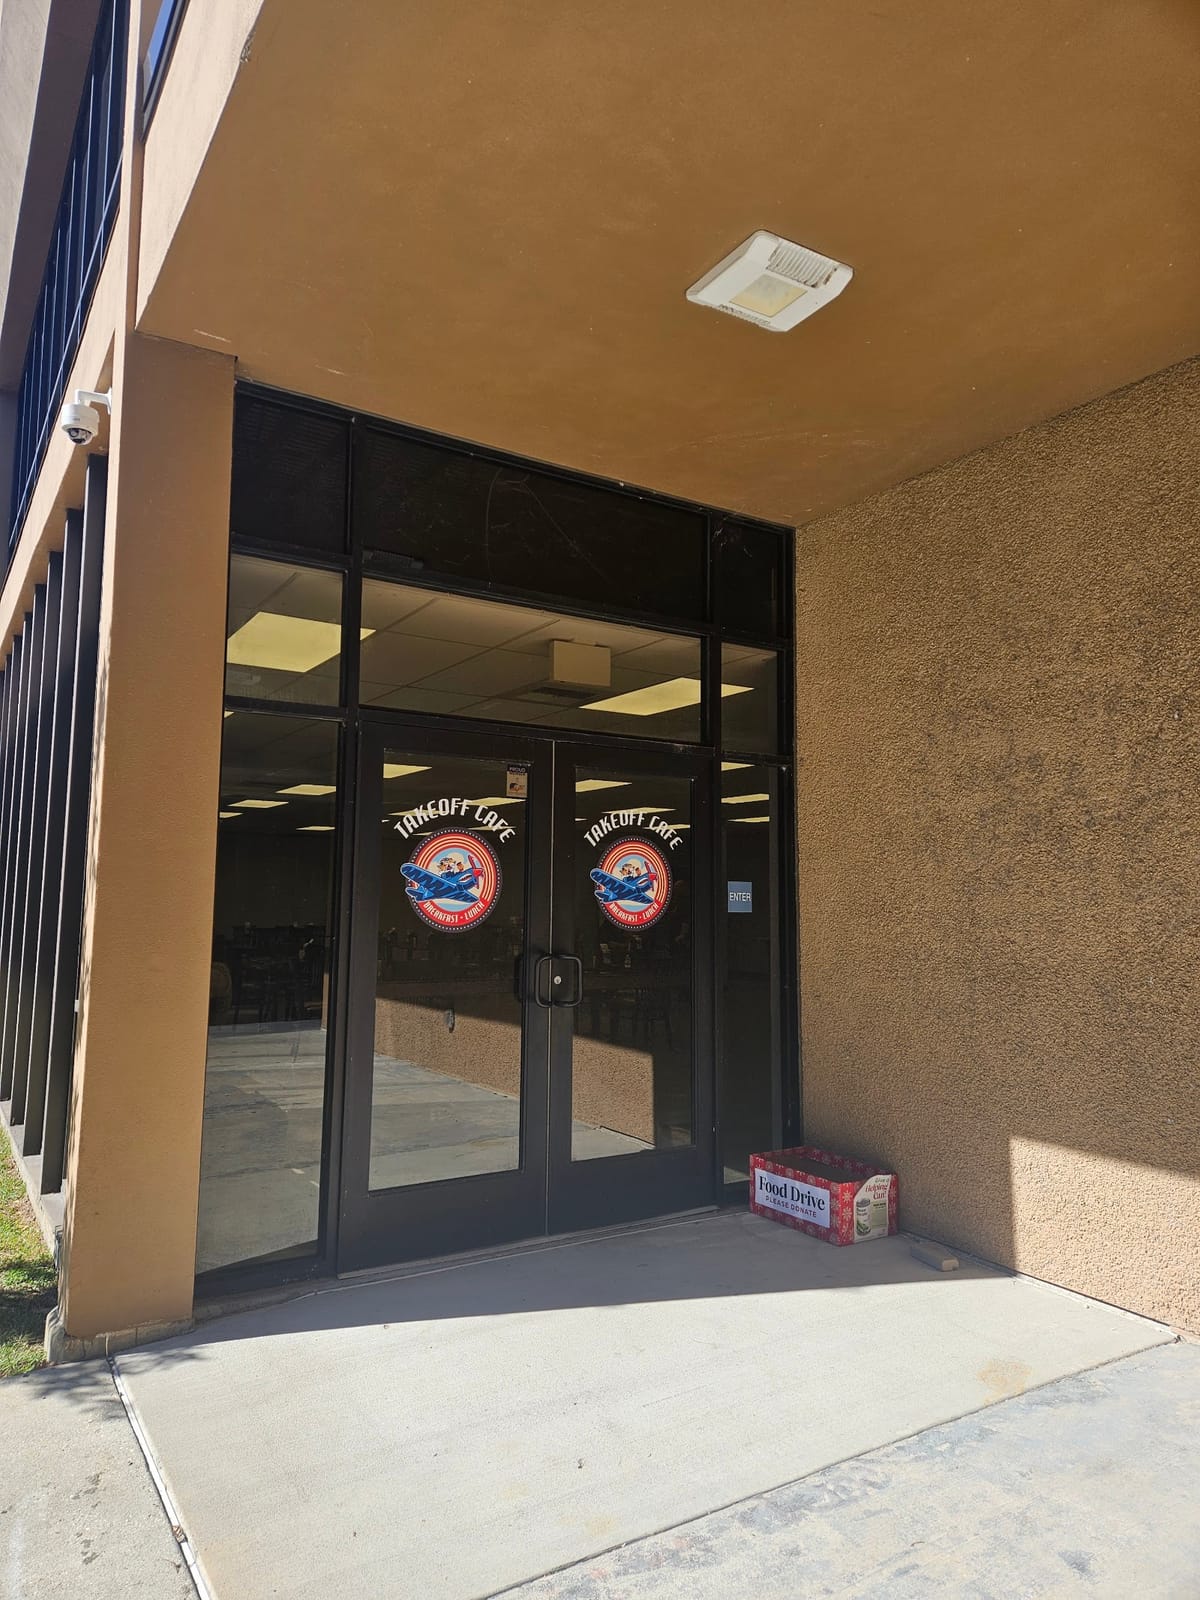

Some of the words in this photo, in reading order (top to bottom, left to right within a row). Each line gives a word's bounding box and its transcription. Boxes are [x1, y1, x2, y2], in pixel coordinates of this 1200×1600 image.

[393, 797, 473, 839] TAKEOFF
[474, 805, 516, 844] CAFE
[583, 811, 645, 847] TAKEOFF
[648, 815, 684, 851] CAFE
[729, 892, 752, 902] ENTER
[423, 901, 459, 924] BREAKFAST
[464, 901, 485, 920] LUNCH
[609, 902, 638, 922] BREAKFAST
[642, 902, 660, 920] LUNCH
[759, 1176, 787, 1199] Food
[791, 1186, 825, 1211] Drive
[765, 1195, 789, 1209] PLEASE
[790, 1204, 817, 1218] DONATE
